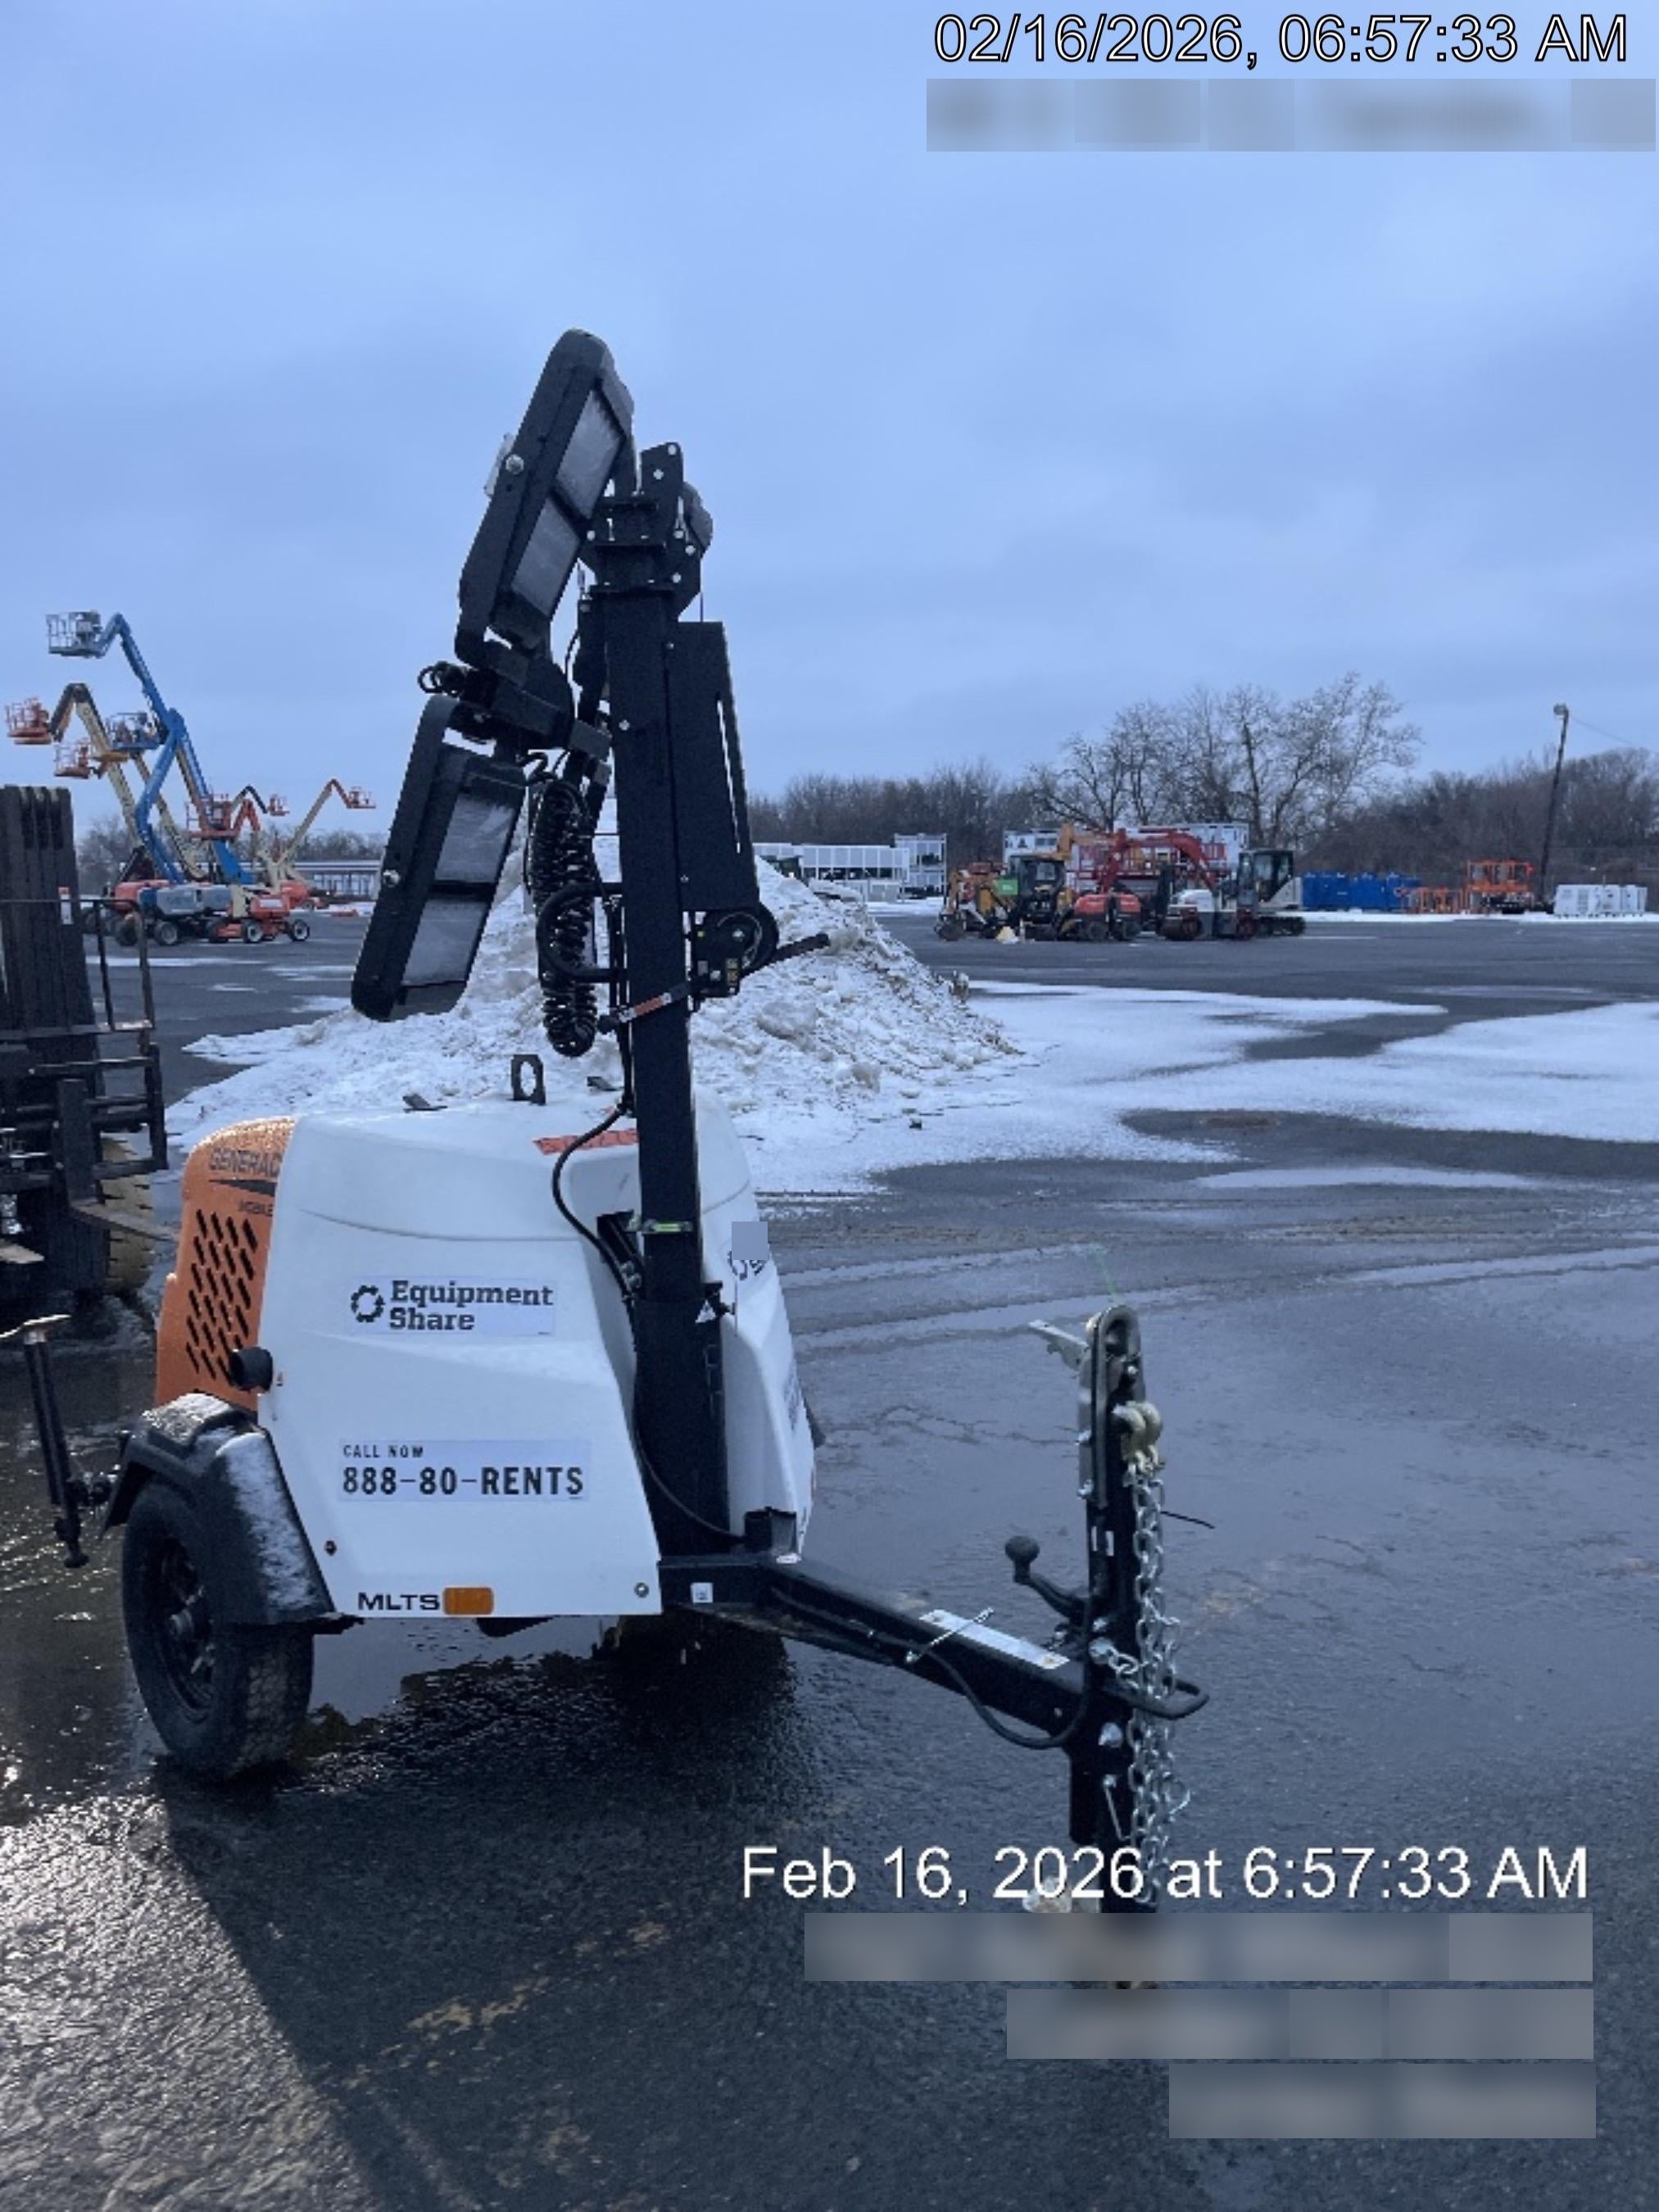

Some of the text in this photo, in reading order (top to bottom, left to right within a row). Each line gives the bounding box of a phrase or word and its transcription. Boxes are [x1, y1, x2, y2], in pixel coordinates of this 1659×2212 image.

[390, 1280, 554, 1308] Equipment
[389, 1307, 475, 1330] Share
[342, 1444, 424, 1458] CALL NOW
[342, 1466, 584, 1495] 888-80-RENTS
[357, 1592, 441, 1611] MLTS
